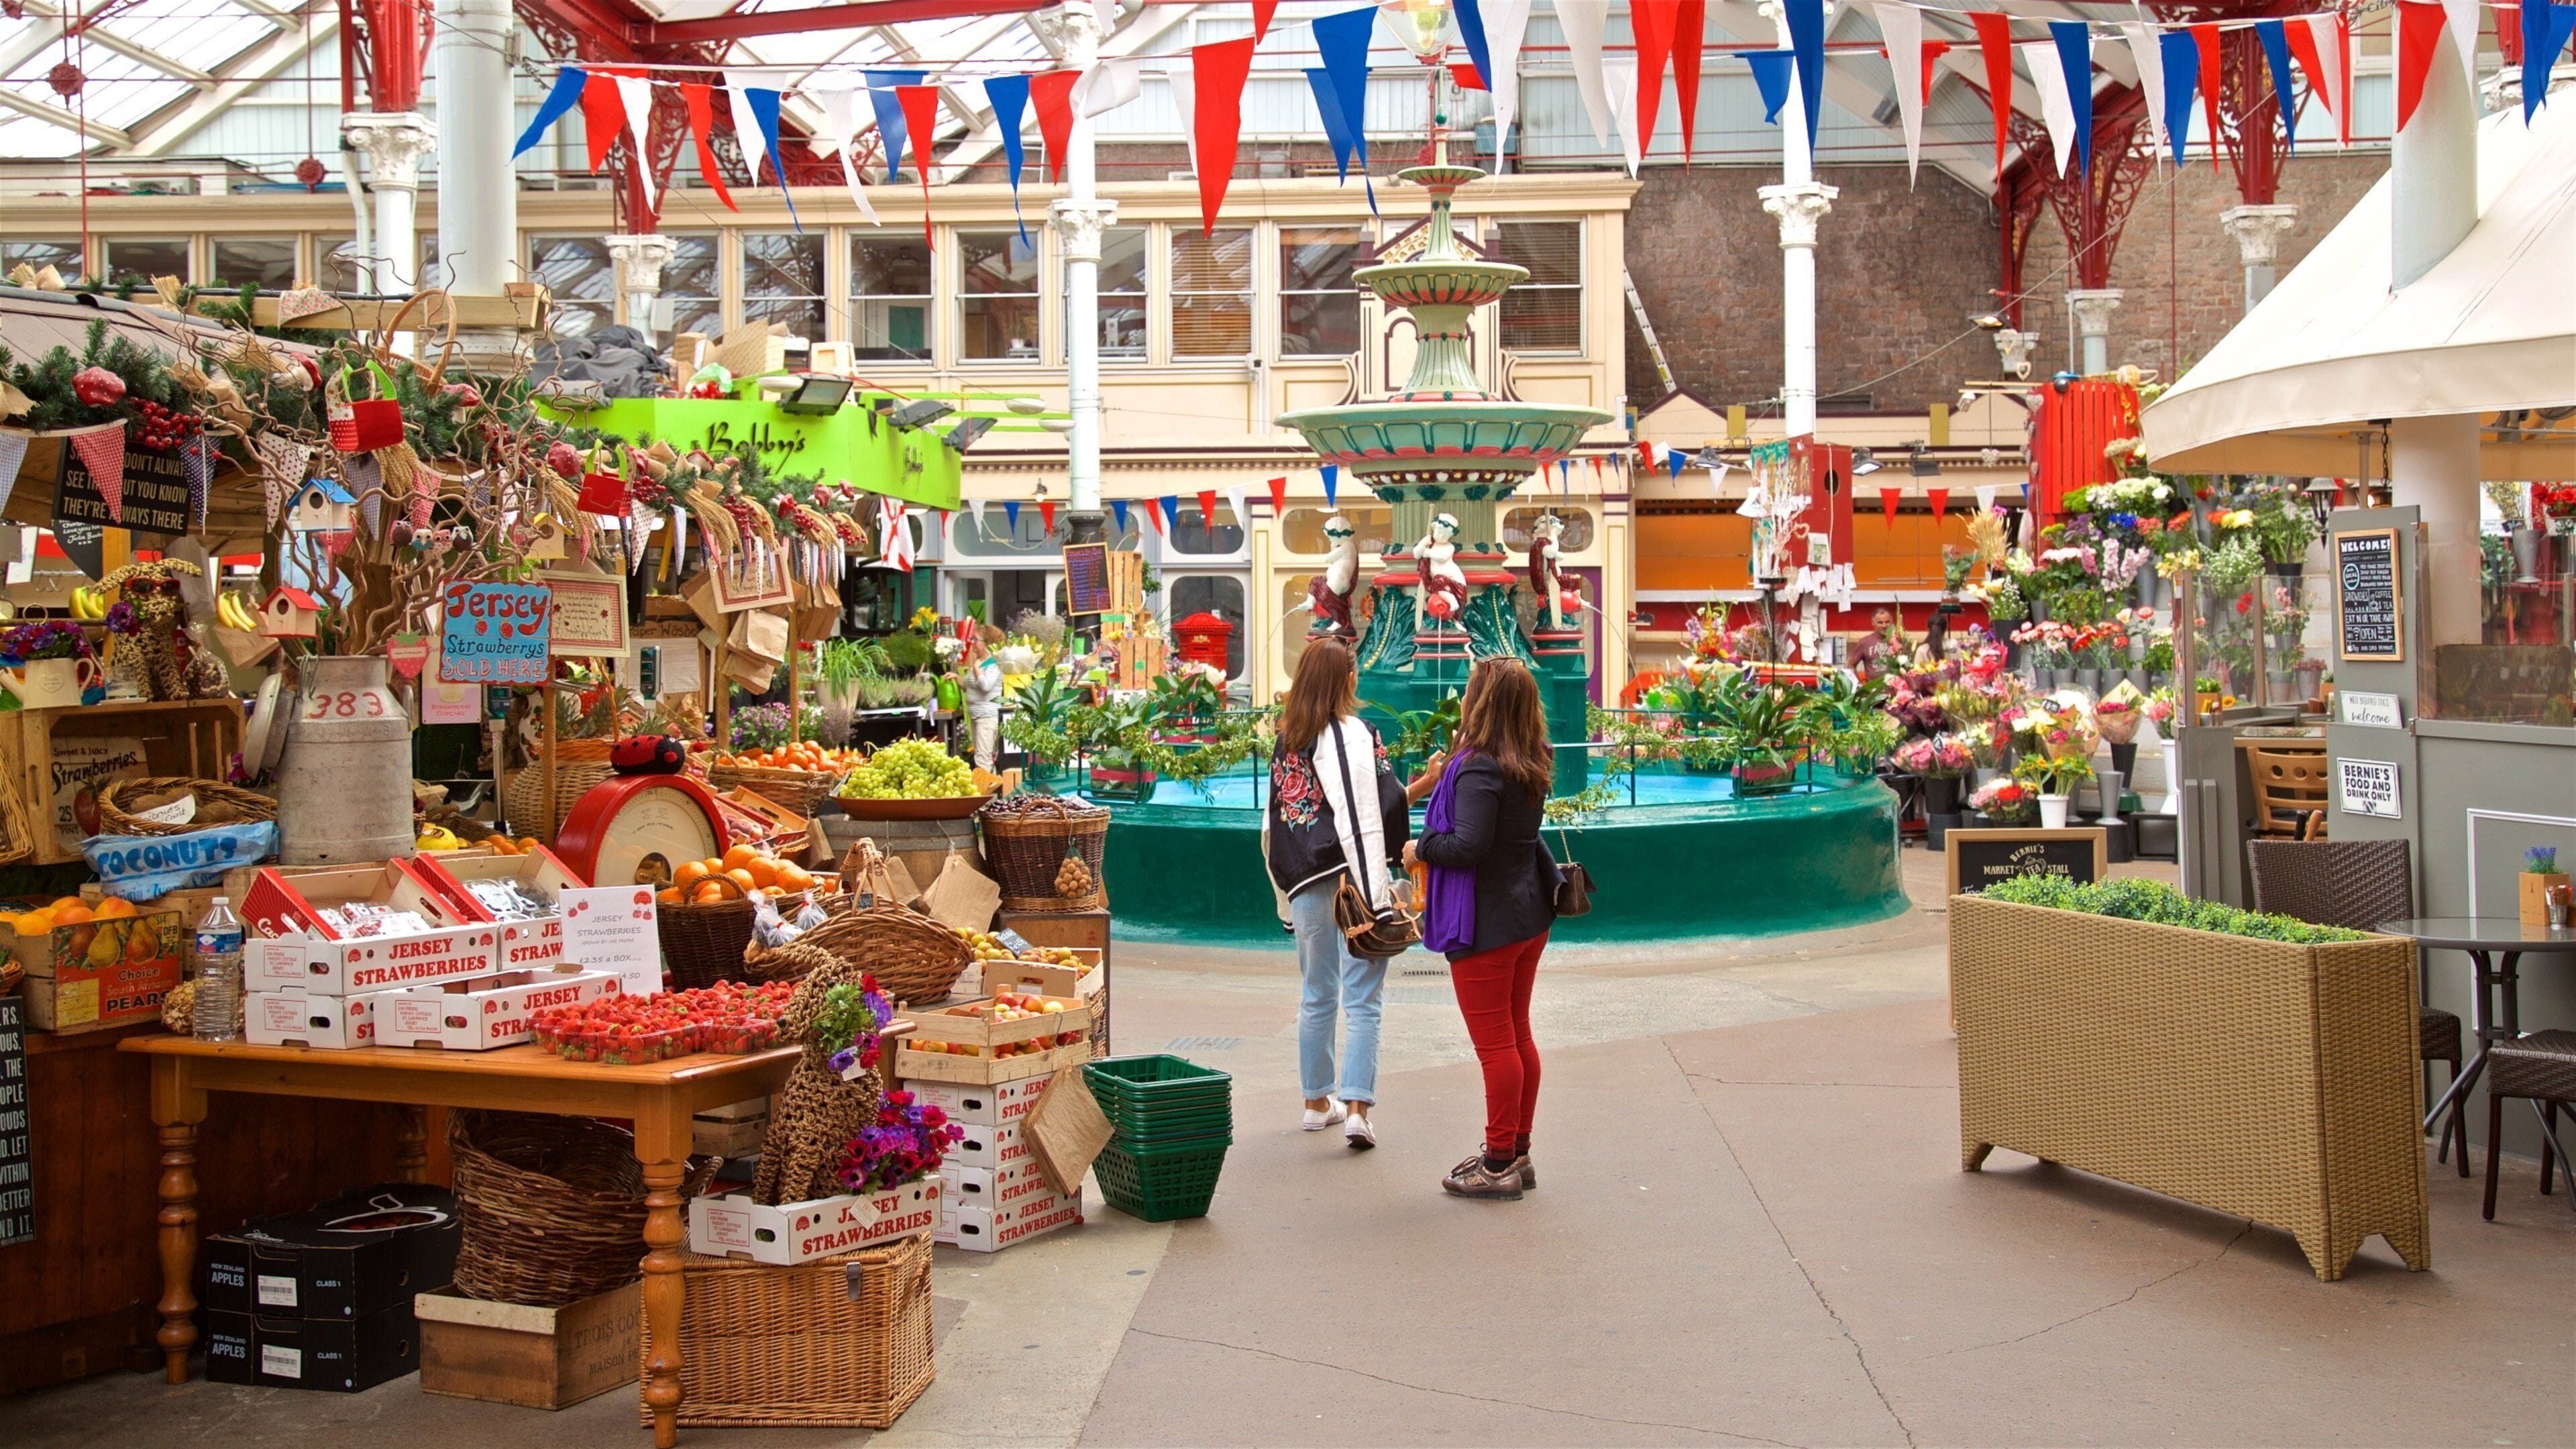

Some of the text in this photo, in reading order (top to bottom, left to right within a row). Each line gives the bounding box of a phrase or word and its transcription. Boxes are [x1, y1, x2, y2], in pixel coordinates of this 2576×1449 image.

[708, 421, 806, 474] Bobby's
[125, 452, 152, 469] DON'T
[66, 470, 86, 489] SEE
[123, 478, 137, 496] UT
[138, 481, 158, 500] YOU
[158, 484, 189, 504] KNOW
[63, 496, 106, 519] THEY'RE
[152, 509, 185, 530] THERE
[2341, 539, 2390, 553] WELCOME!
[447, 583, 549, 635] Jersey
[2361, 628, 2377, 639] OPEN
[447, 633, 545, 659] Strawberrys
[444, 657, 545, 679] SOLD HERE
[2352, 708, 2390, 724] welcome
[53, 747, 78, 757] Sweet
[80, 747, 87, 755] &
[51, 751, 137, 796] Strawberries
[2345, 765, 2390, 782] BERNIE'S
[2346, 778, 2391, 792] FOOD AND
[2347, 788, 2392, 802] DRINK ONLY
[58, 805, 72, 822] 25
[97, 837, 237, 877] COCONUTS
[2009, 843, 2045, 863] BERNIE'S
[1984, 863, 2069, 876] MARKET TEA STALL
[592, 914, 623, 923] JERSEY
[162, 924, 178, 936] DFB
[577, 927, 641, 937] STRAWBERRIES
[389, 938, 453, 960] JERSEY
[119, 967, 160, 983] Choice
[354, 955, 486, 986] STRAWBERRIES
[106, 982, 136, 997] South
[524, 986, 581, 1010] JERSEY
[5, 1058, 23, 1079] THE
[11, 1136, 27, 1157] LET
[1019, 1195, 1056, 1219] JERSEY
[19, 1215, 33, 1235] IT.
[802, 1210, 932, 1256] STRAWBERRIES
[998, 1206, 1075, 1244] STRAWBERRIES
[223, 1264, 245, 1273] ZEALAND
[211, 1271, 244, 1287] APPLES
[225, 1335, 246, 1344] ZEALAND
[212, 1342, 246, 1358] APPLES
[589, 1352, 625, 1375] MAISON
